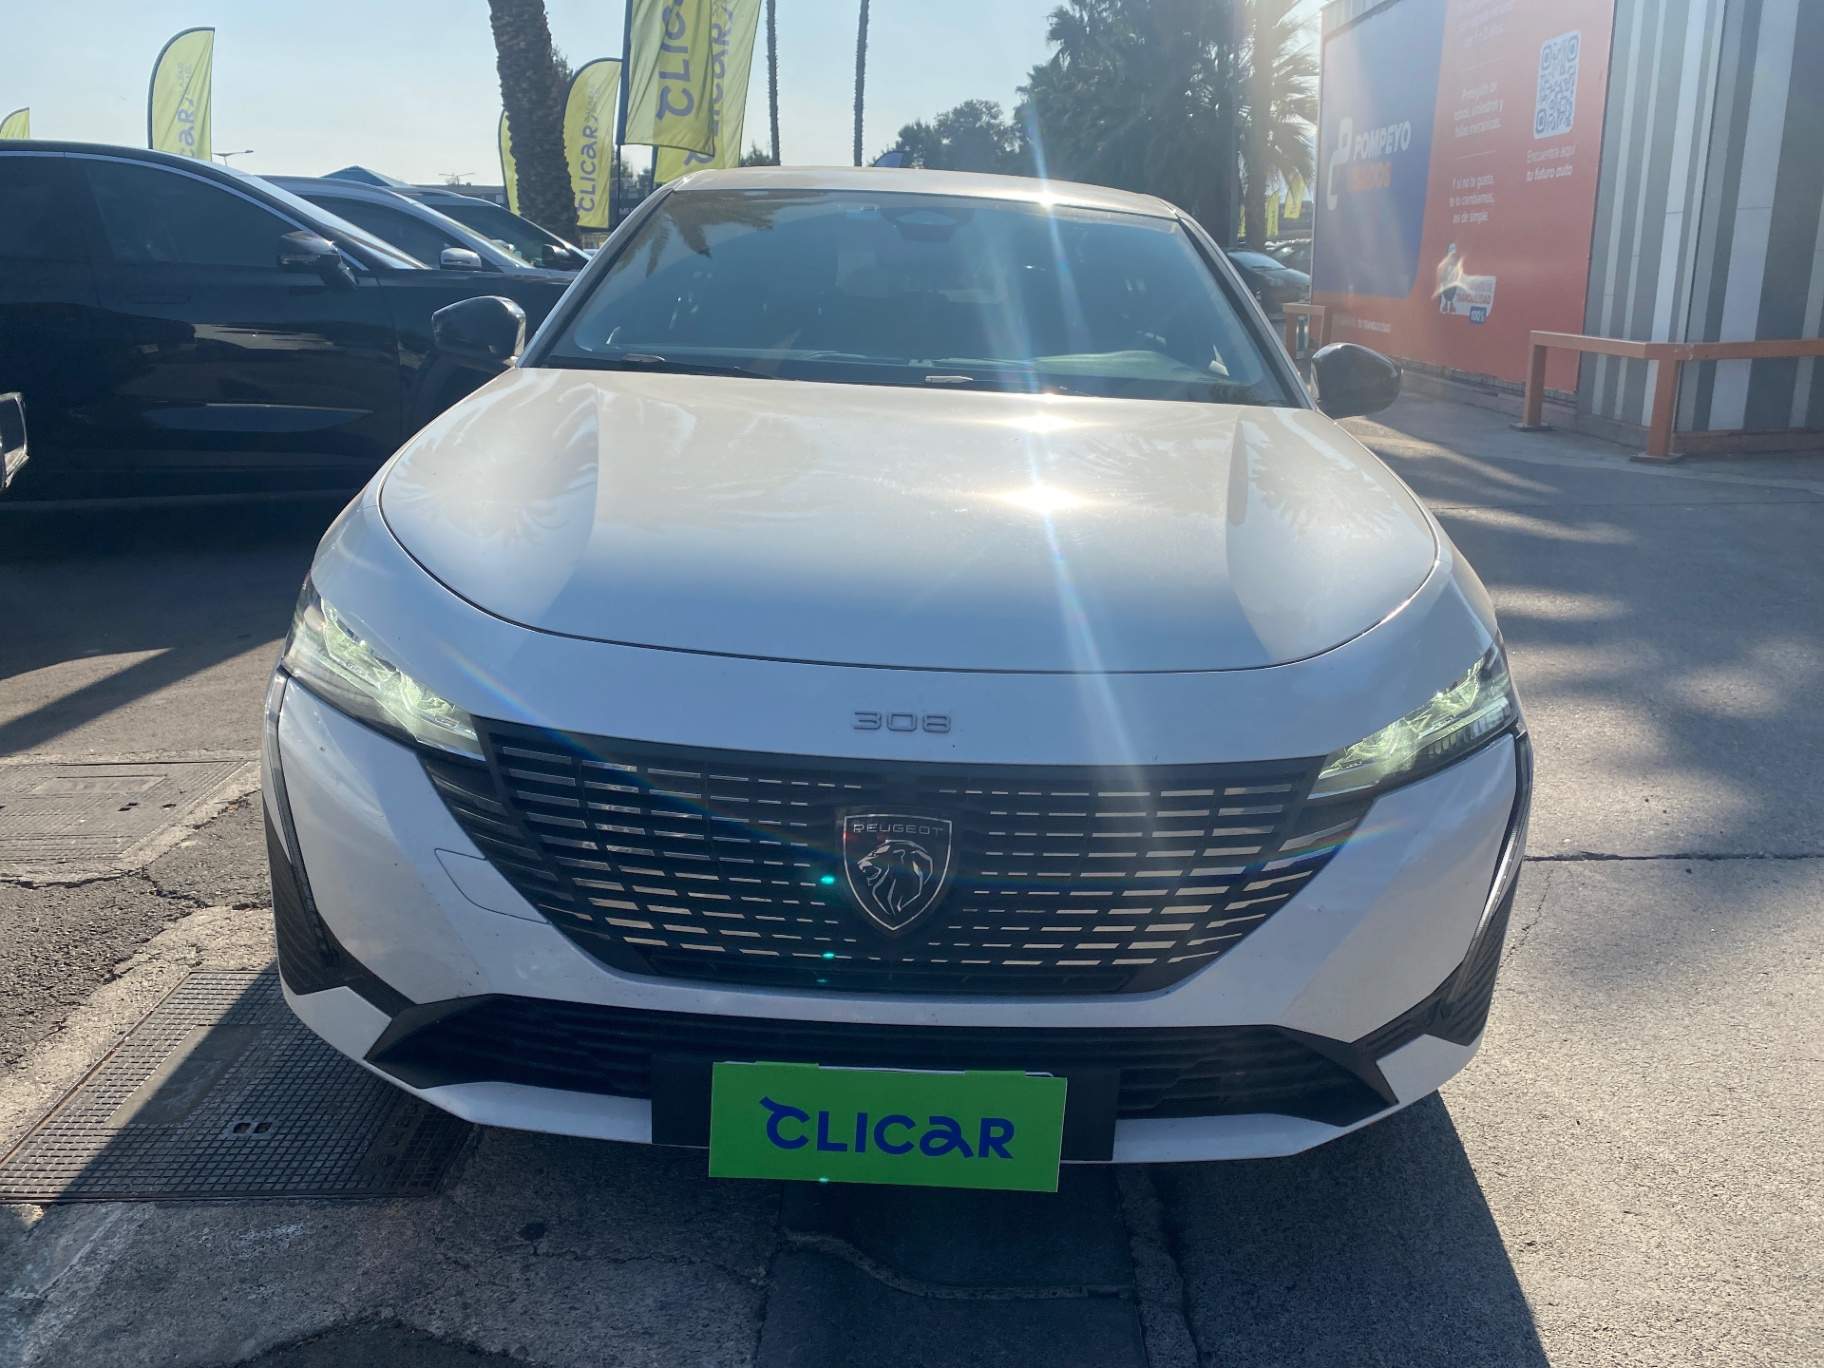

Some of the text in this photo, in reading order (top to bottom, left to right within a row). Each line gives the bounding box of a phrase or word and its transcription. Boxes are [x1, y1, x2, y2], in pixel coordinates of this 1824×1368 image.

[656, 0, 694, 120] CLIC
[1353, 120, 1411, 160] POMPEYO
[853, 711, 951, 733] 308
[853, 823, 944, 835] PEUGEOT
